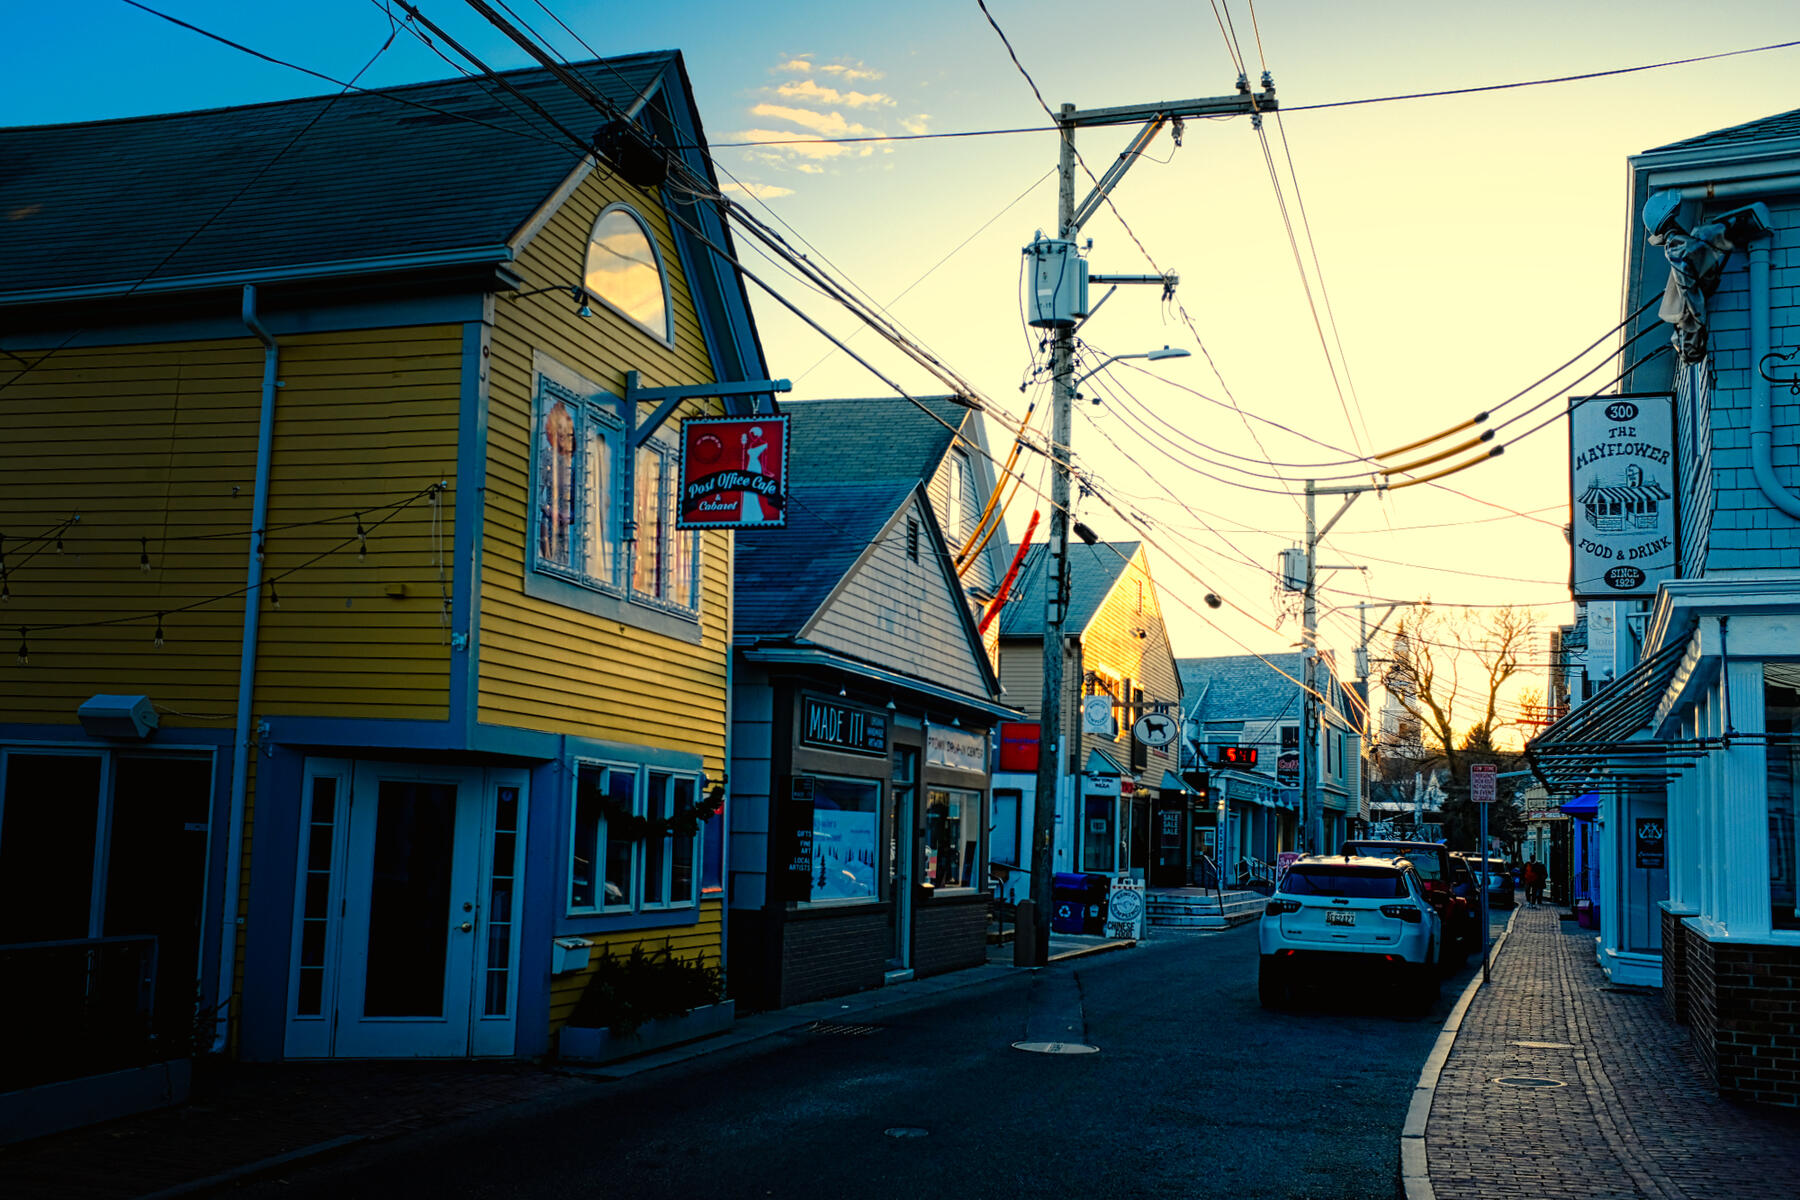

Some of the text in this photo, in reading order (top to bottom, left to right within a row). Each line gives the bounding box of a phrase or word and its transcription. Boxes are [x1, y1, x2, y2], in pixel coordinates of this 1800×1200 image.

[1610, 405, 1634, 419] 300
[1608, 426, 1637, 439] THE
[1576, 443, 1671, 471] MAYFLOWER
[688, 472, 777, 499] Post Office Cafe
[697, 501, 738, 511] Cabaret
[1578, 535, 1672, 560] FOOD & DRINK
[1610, 568, 1640, 579] SINCE
[1615, 579, 1635, 587] 1929
[808, 704, 845, 743] MADE
[849, 711, 864, 747] IT!
